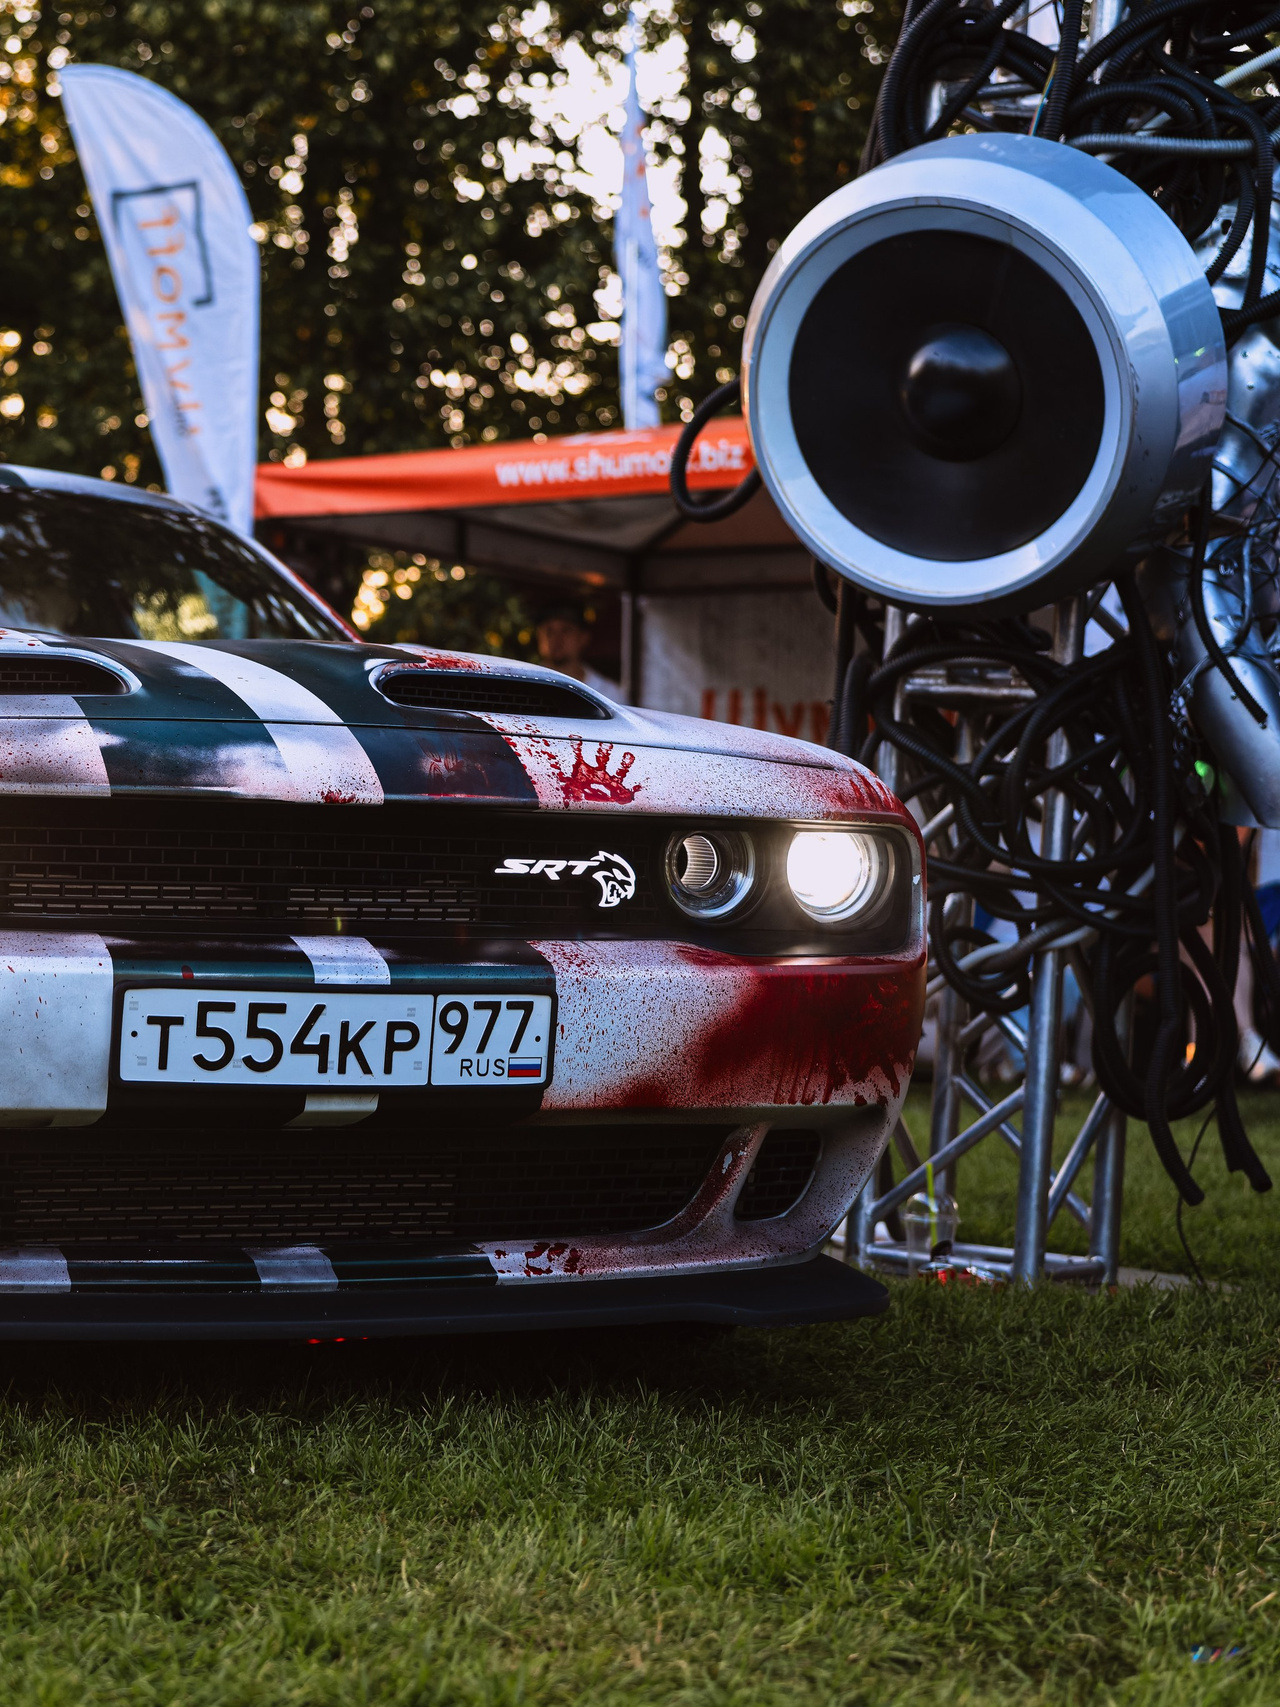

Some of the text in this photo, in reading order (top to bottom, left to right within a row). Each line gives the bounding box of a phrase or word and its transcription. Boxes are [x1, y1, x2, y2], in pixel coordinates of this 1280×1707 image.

[495, 438, 745, 486] www.shumo.biz
[494, 858, 601, 881] SRT
[145, 1001, 421, 1075] Т554КР
[438, 1001, 535, 1055] 977
[459, 1058, 506, 1078] RUS
